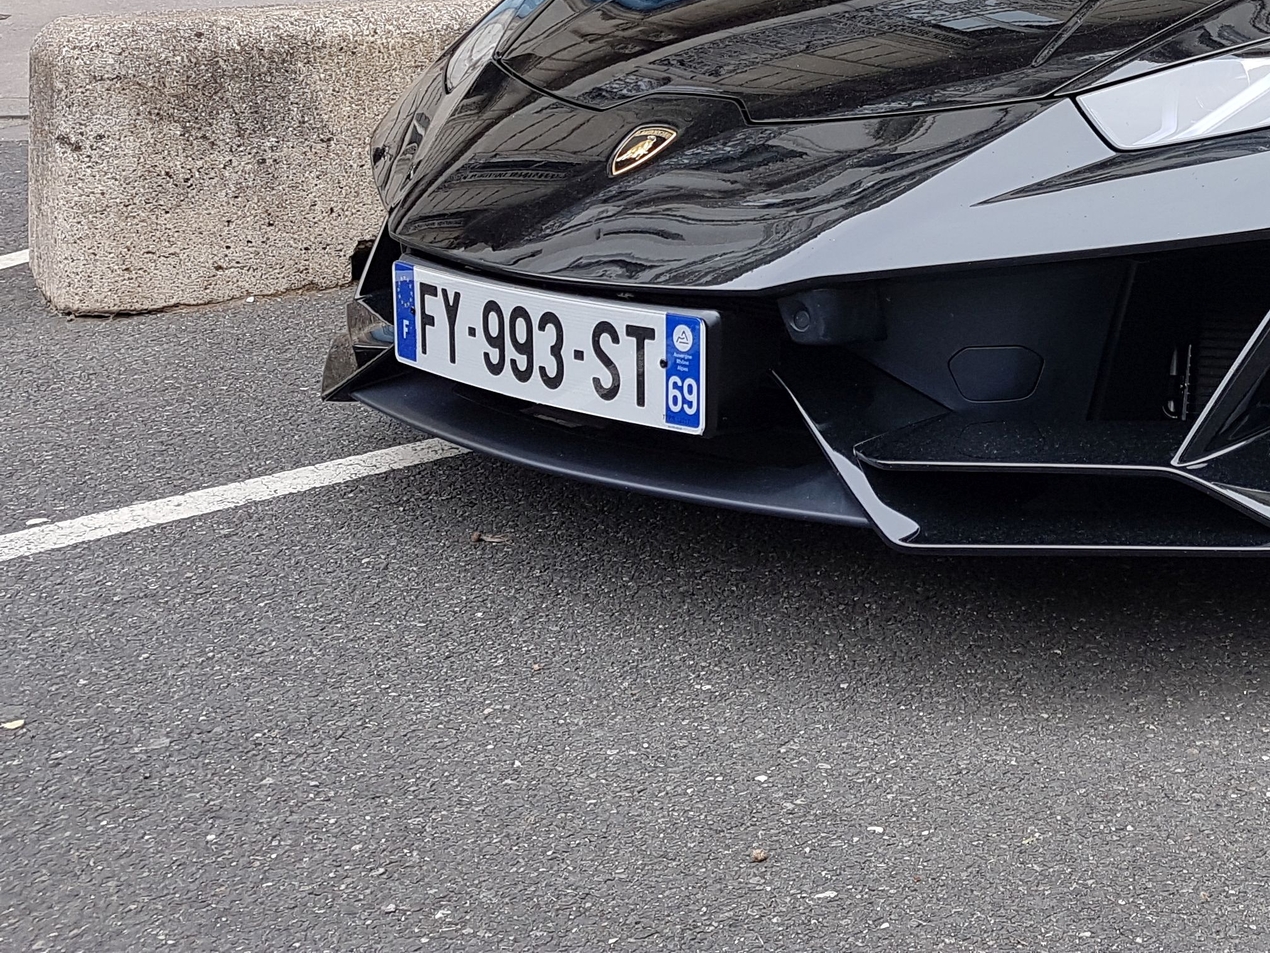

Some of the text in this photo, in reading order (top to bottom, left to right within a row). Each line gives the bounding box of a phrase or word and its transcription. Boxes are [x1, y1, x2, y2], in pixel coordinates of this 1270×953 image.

[403, 319, 410, 339] F
[419, 281, 656, 408] FY-993-ST
[668, 375, 698, 415] 69
